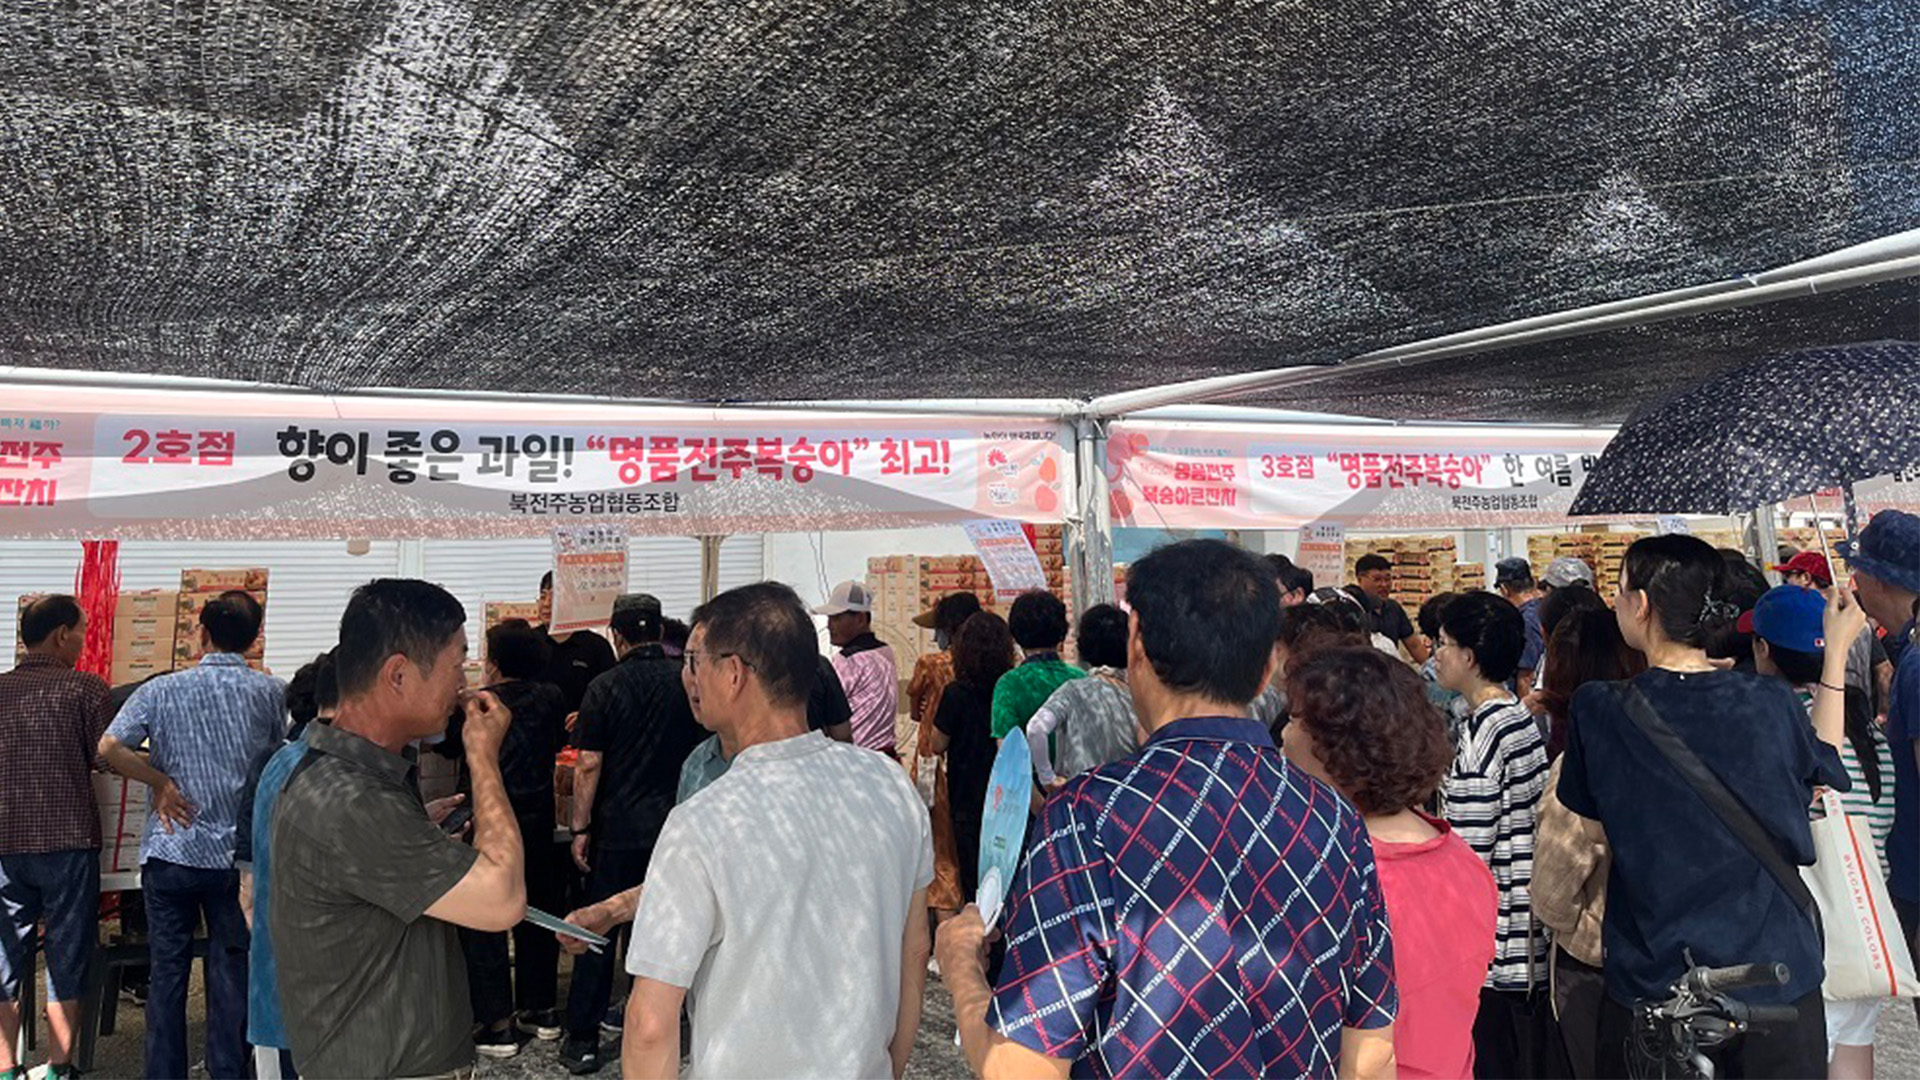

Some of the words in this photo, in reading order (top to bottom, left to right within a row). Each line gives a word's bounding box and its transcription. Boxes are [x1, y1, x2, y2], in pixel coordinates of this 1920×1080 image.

[122, 429, 235, 466] 2호점
[276, 425, 369, 482] 향이
[384, 430, 464, 485] 좋은
[477, 433, 574, 483] 과일!
[880, 437, 950, 475] 최고!
[1261, 454, 1315, 479] 3호점
[1502, 452, 1524, 487] 한
[1535, 453, 1572, 487] 여름
[509, 492, 679, 515] 북전주농업협동조합
[1452, 494, 1537, 510] 북전주농업협동조합
[1861, 917, 1881, 970] COLORS
